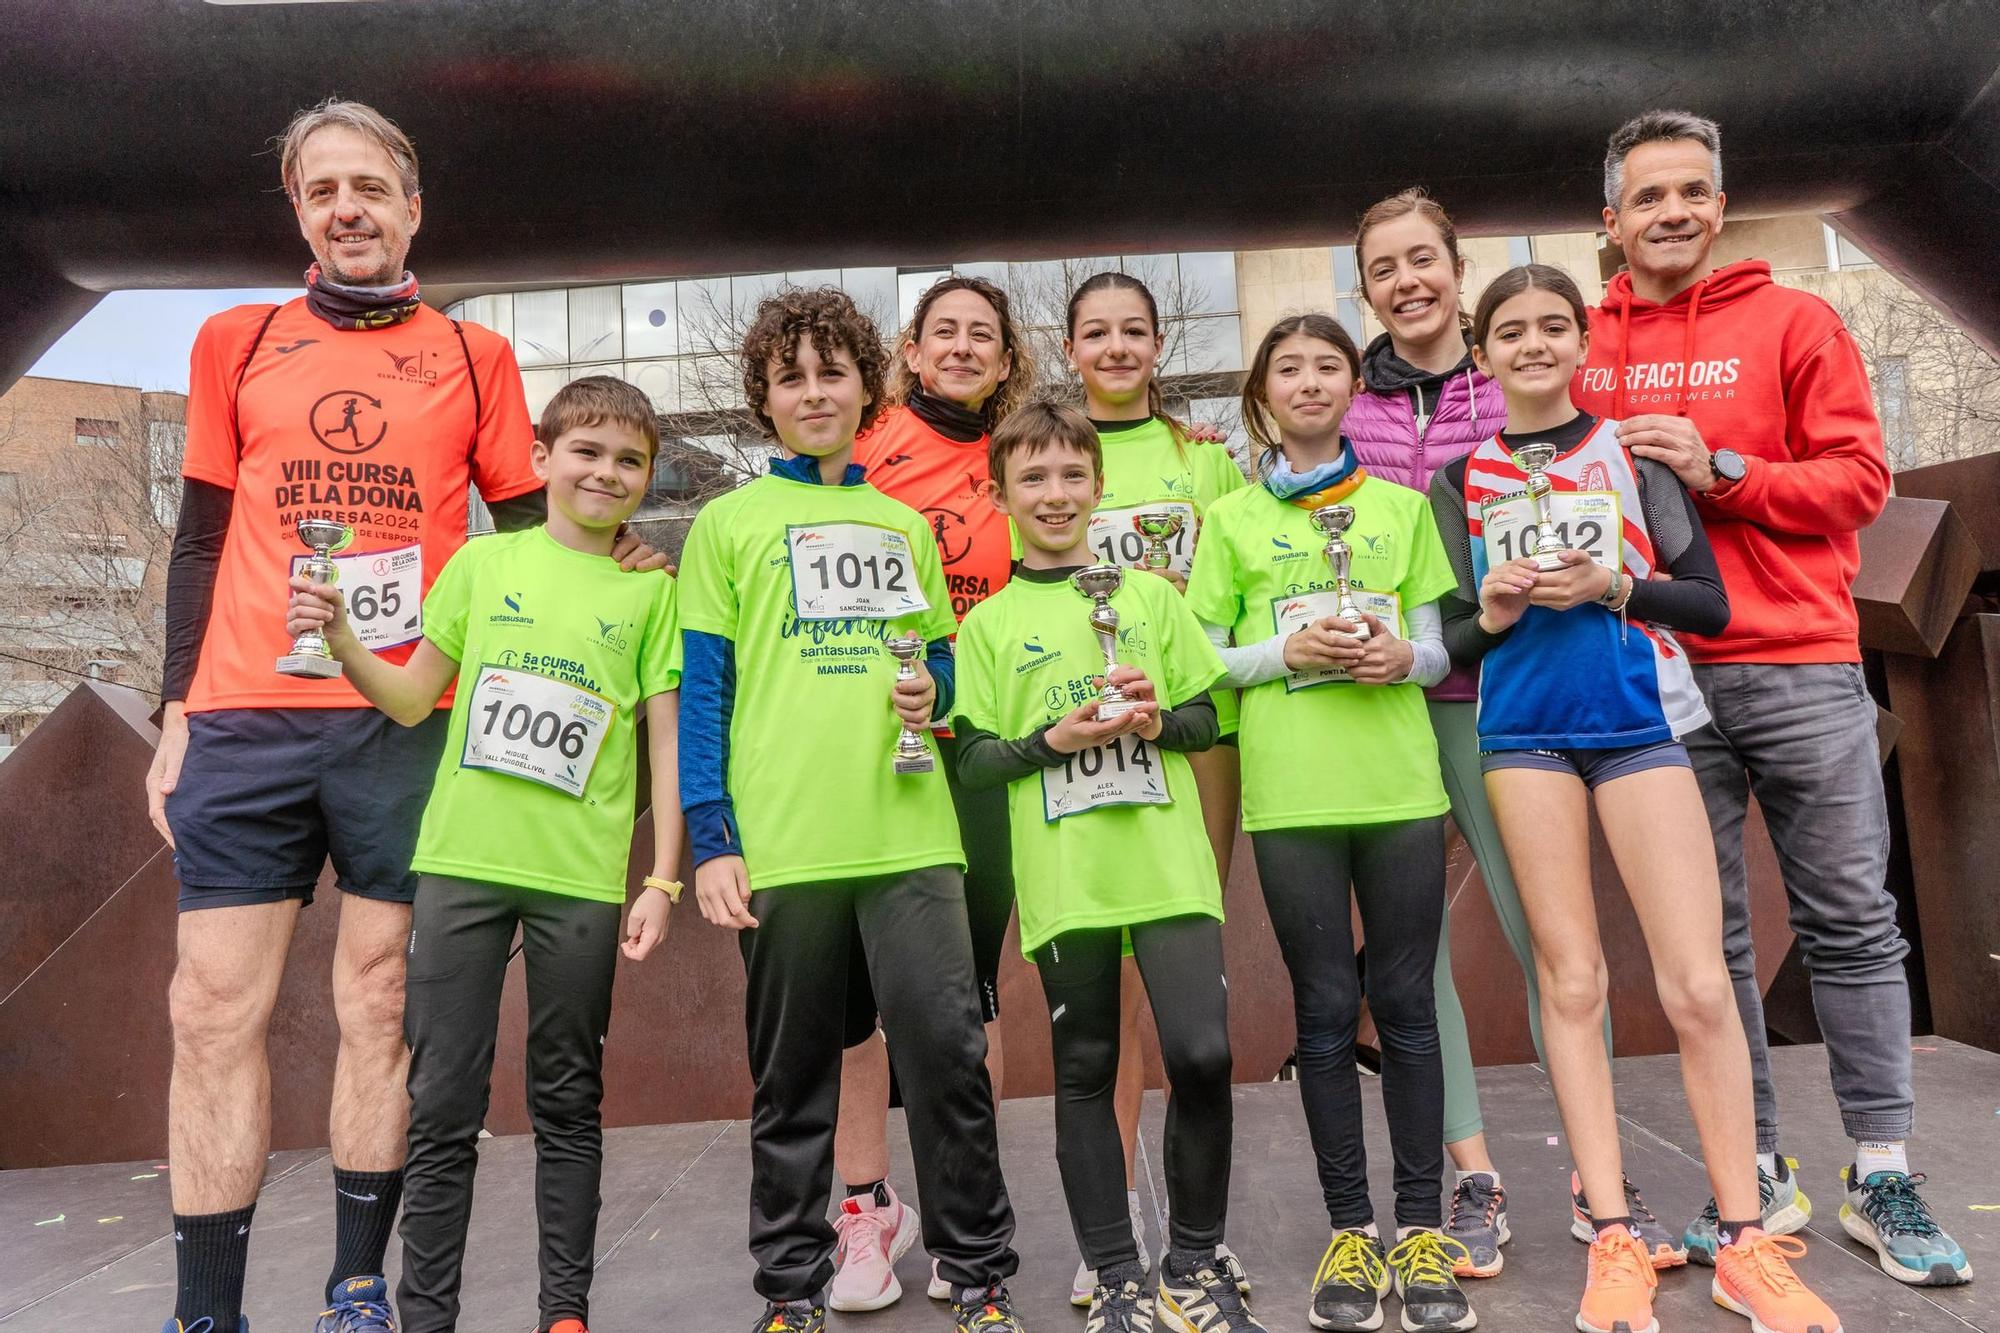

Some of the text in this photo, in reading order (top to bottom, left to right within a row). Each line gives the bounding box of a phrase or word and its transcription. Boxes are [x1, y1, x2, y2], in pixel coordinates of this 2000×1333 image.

[381, 347, 437, 380] Vela
[281, 460, 416, 488] VIII CURSA
[275, 483, 424, 513] DE LA DONA
[375, 531, 419, 543] L'ESPORT
[1098, 527, 1186, 564] 107
[1271, 551, 1309, 562] tasusana
[810, 552, 908, 592] 1012
[946, 574, 989, 598] RSA
[1325, 580, 1364, 589] CSA
[343, 580, 401, 622] 65
[489, 614, 534, 625] santasusana
[594, 615, 627, 650] Vela
[800, 645, 880, 658] santasusana
[1016, 650, 1062, 674] santasusana
[523, 652, 539, 665] 5a
[541, 655, 585, 675] CURSA
[817, 665, 868, 675] MANRESA
[1067, 679, 1083, 691] 5a
[1071, 691, 1087, 704] DE
[483, 700, 588, 759] 1006
[1064, 737, 1153, 784] 1014
[1090, 792, 1105, 800] RUIZ
[1097, 782, 1114, 790] ALEX
